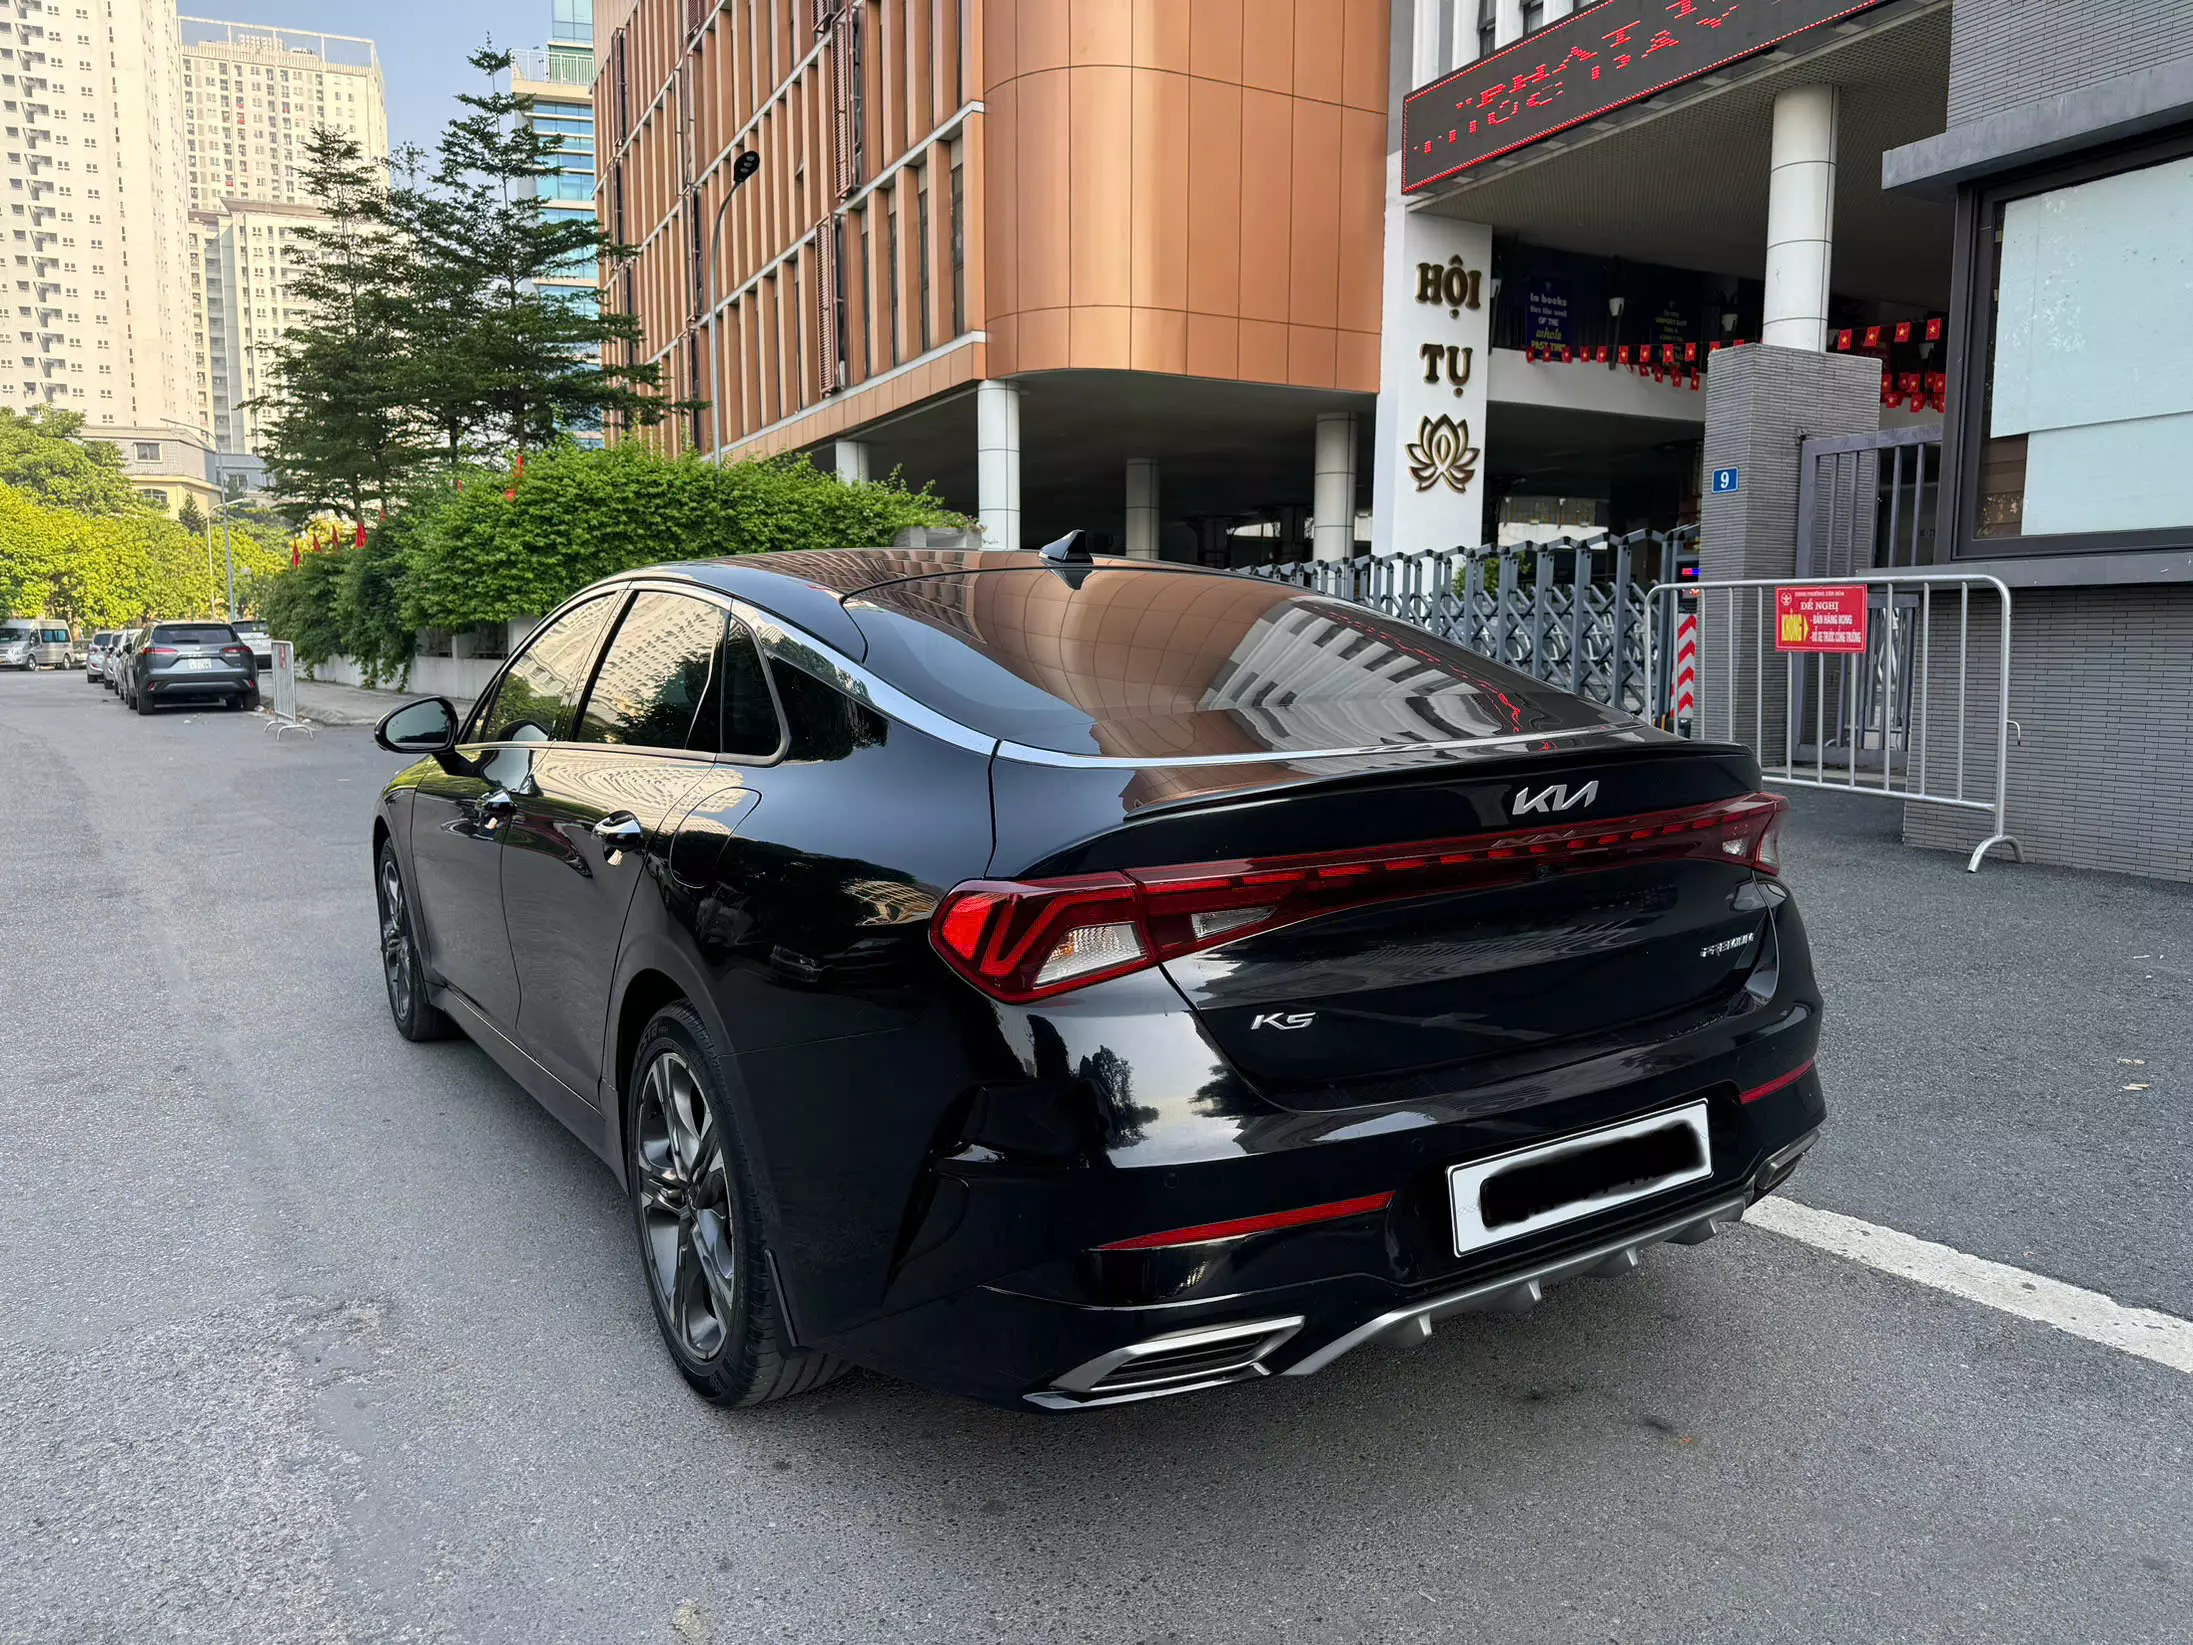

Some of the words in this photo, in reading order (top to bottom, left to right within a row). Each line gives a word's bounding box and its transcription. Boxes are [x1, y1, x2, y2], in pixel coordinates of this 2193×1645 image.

[1415, 254, 1482, 320] HỘI
[1541, 294, 1568, 306] books
[1419, 343, 1473, 398] TỤ
[1720, 471, 1730, 489] 9
[1815, 601, 1839, 612] NGHỊ
[1512, 780, 1599, 815] KIA
[1250, 1012, 1317, 1030] K5
